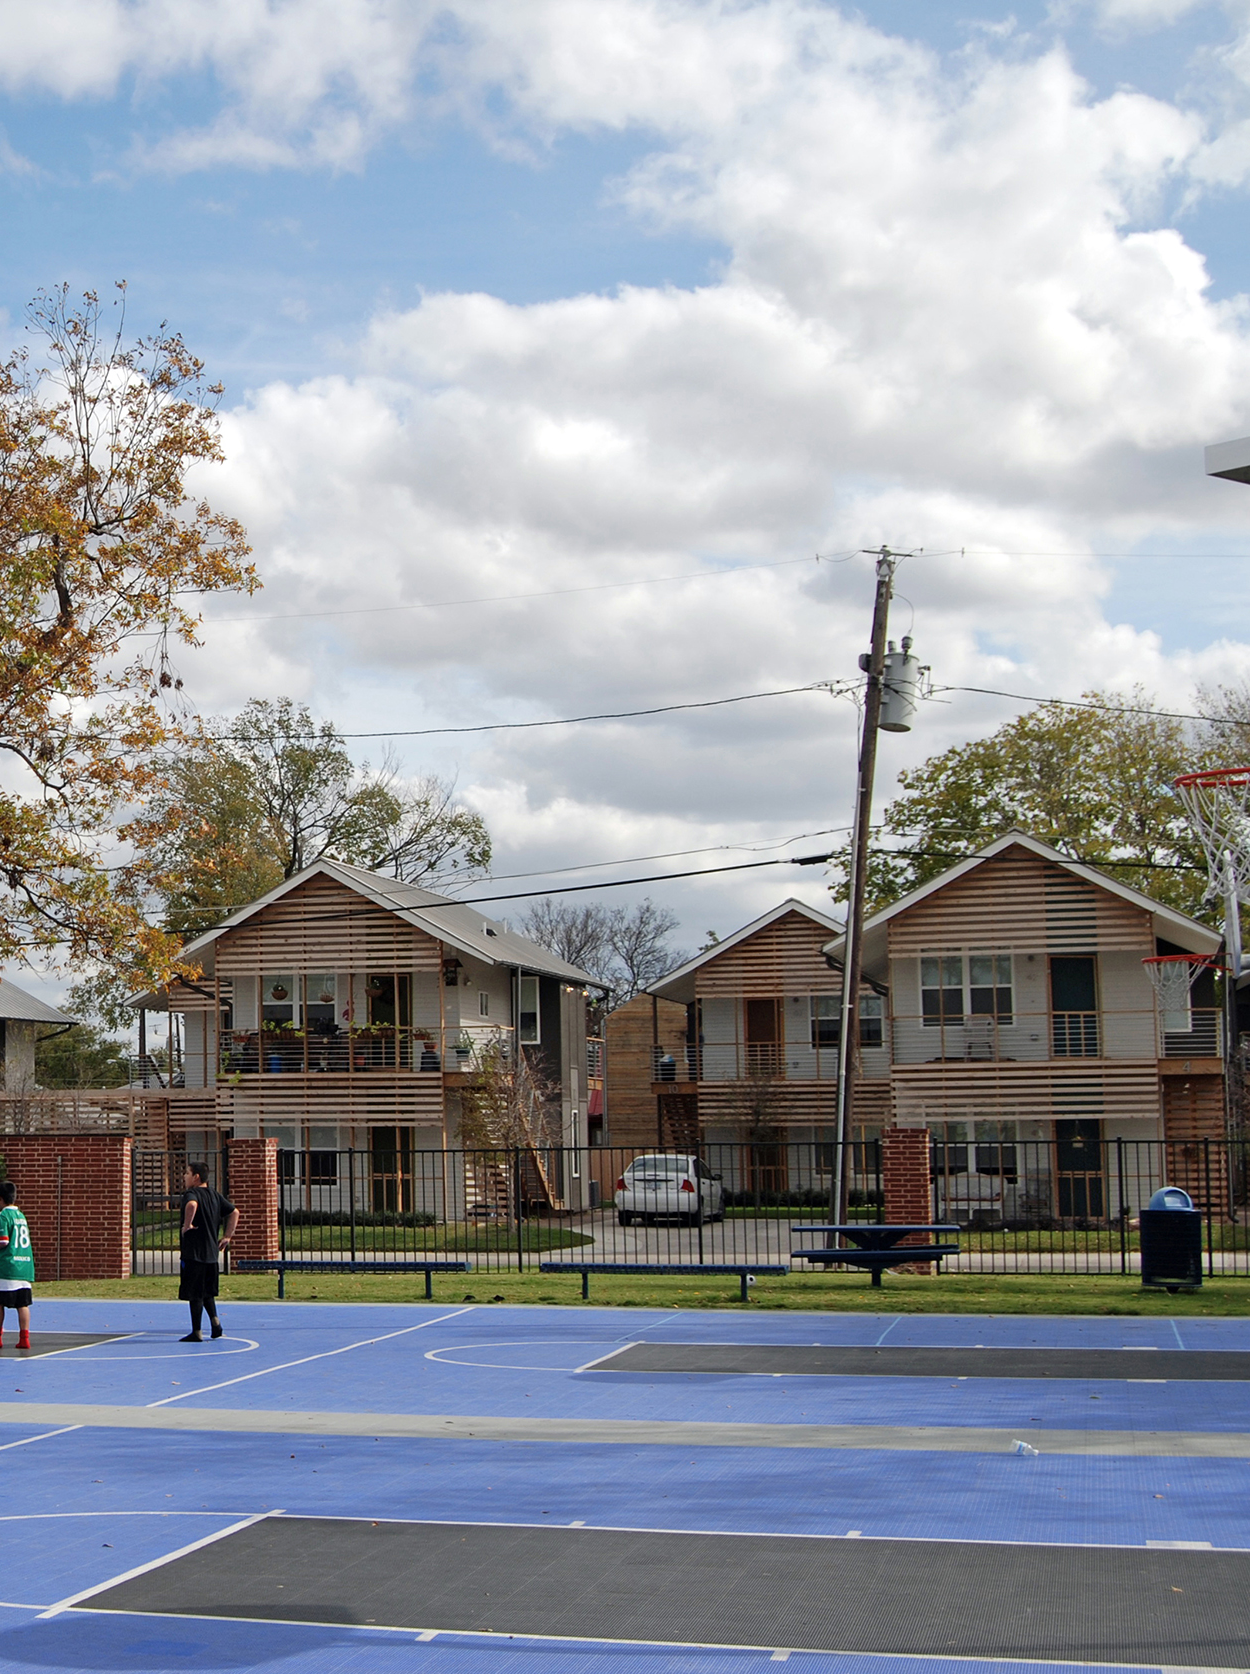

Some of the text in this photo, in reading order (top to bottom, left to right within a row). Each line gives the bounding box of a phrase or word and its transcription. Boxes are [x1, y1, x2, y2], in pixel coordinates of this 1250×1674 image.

[1182, 1060, 1191, 1072] 4
[667, 1084, 679, 1094] 10
[13, 1225, 30, 1249] 18
